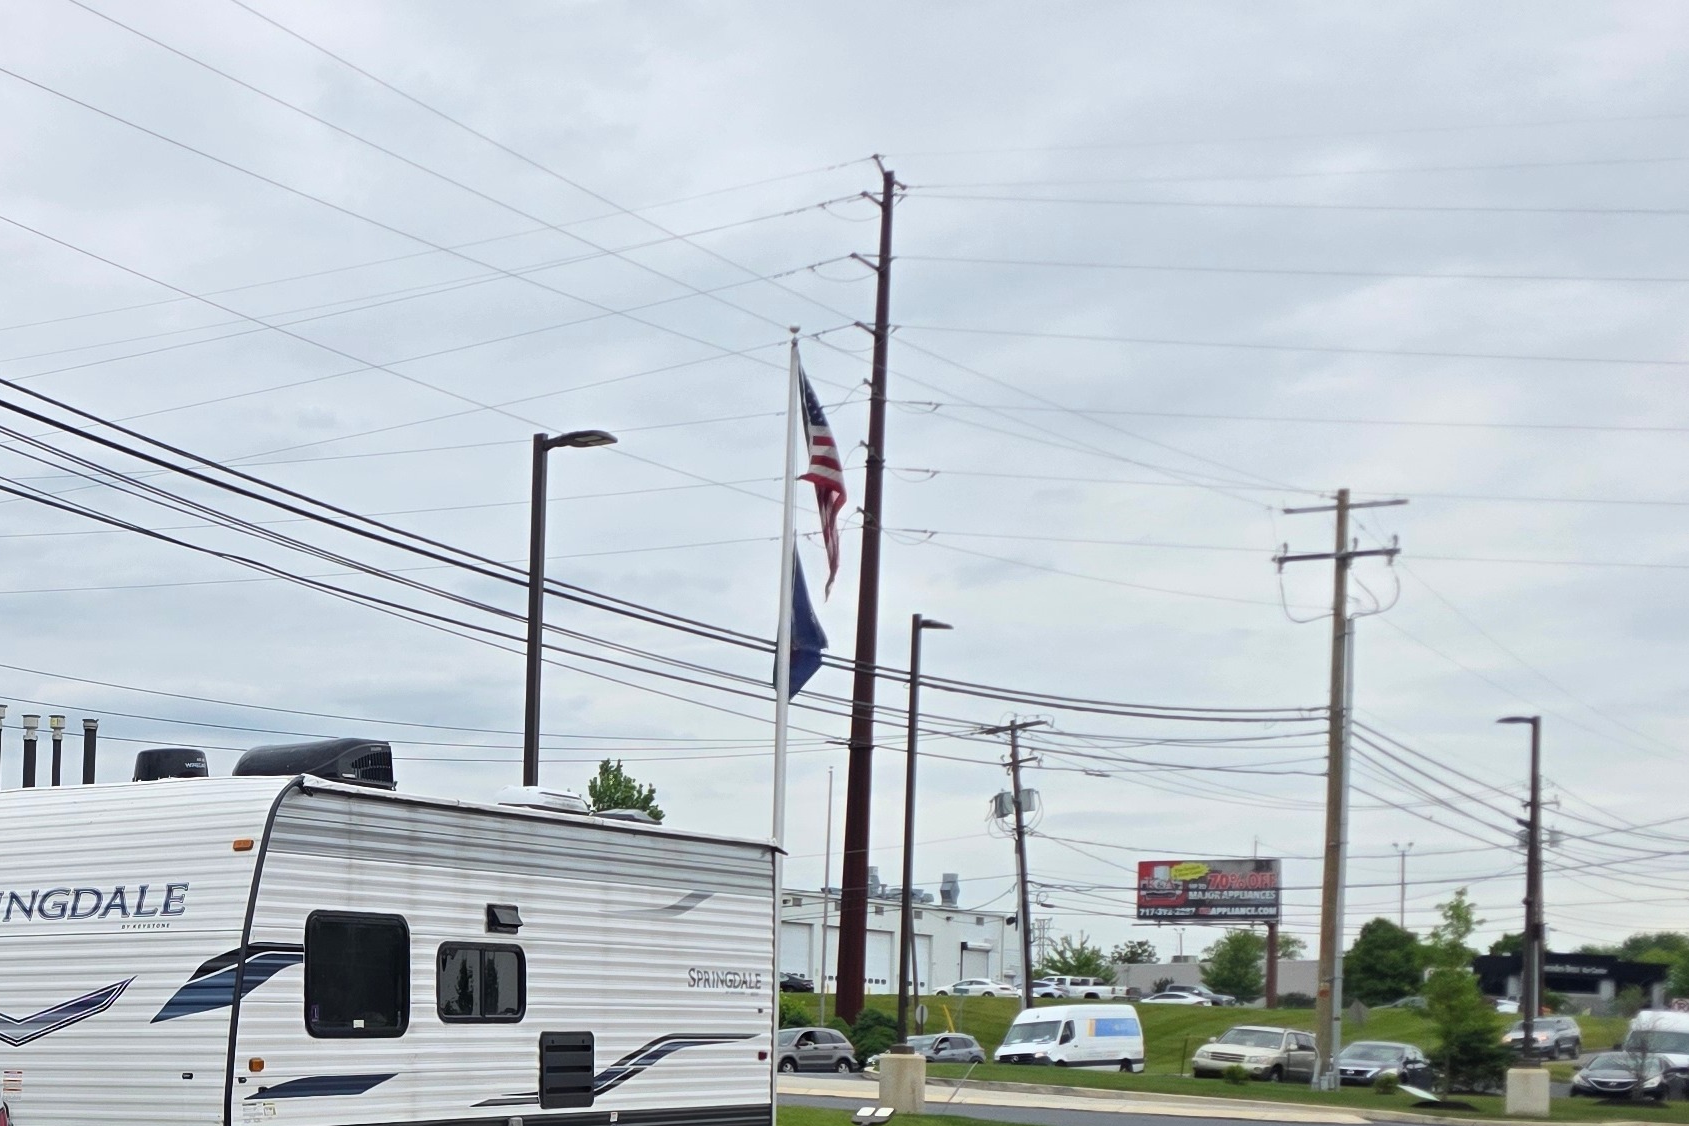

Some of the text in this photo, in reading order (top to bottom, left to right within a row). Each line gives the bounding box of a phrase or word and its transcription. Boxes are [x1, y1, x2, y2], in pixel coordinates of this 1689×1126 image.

[1207, 872, 1247, 890] 70%
[1246, 872, 1277, 889] OFF
[1188, 890, 1277, 900] MAJOR APPLIANCES
[687, 967, 762, 990] SPRINGDALE
